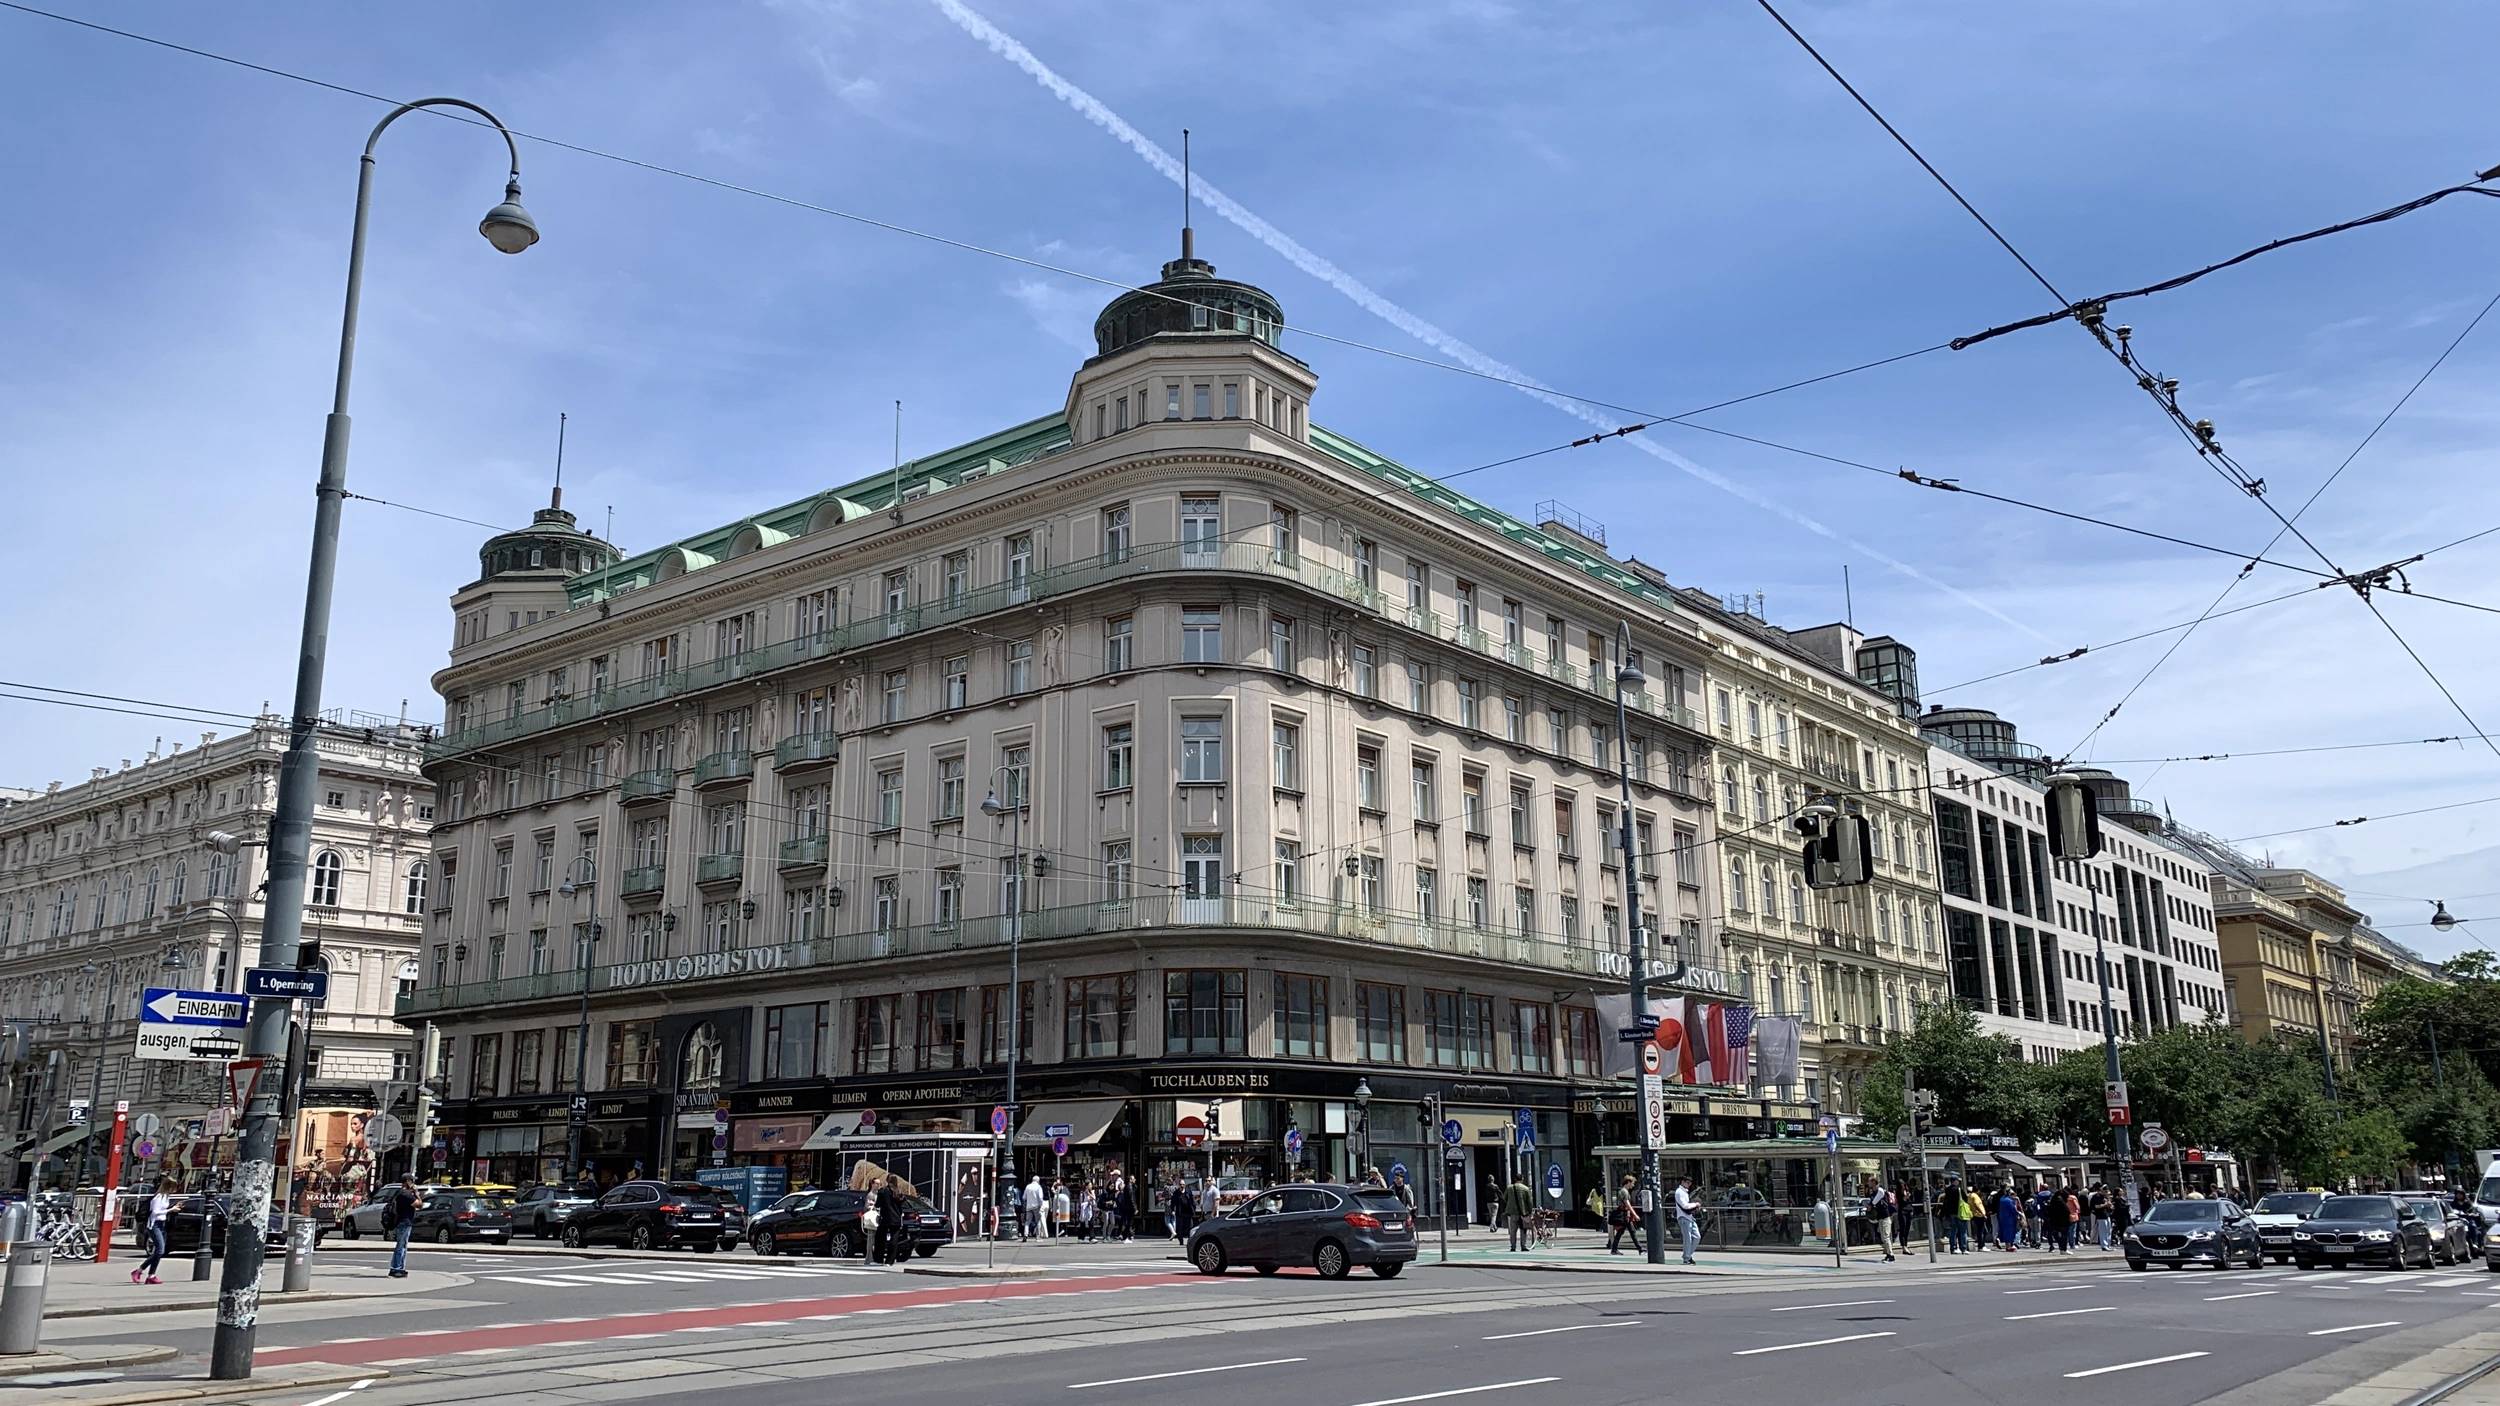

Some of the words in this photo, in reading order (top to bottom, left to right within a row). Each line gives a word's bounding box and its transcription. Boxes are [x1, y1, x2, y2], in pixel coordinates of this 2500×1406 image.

[609, 959, 676, 987] HOTEL
[693, 945, 788, 978] BRISTOL
[1596, 951, 1649, 979] HOTL
[270, 977, 315, 993] Opernring
[177, 1000, 237, 1018] EINBAHN
[140, 1032, 189, 1051] ausgen.
[1150, 1074, 1246, 1088] TUCHLAUBEN
[1249, 1074, 1269, 1087] EIS
[676, 1094, 687, 1107] SIR
[689, 1092, 719, 1106] ANTHONY
[832, 1092, 868, 1104] BLUMEN
[882, 1089, 912, 1101] OPERN
[914, 1087, 962, 1100] APOTHEKE
[571, 1097, 587, 1109] JR
[758, 1096, 793, 1107] MANNER
[1576, 1100, 1633, 1112] BRSTOL
[1668, 1101, 1691, 1113] OTEL
[492, 1109, 519, 1119] PALMERS
[548, 1107, 569, 1117] LINDT
[602, 1103, 623, 1115] LINDT
[1722, 1103, 1749, 1115] BRISTOL
[1781, 1107, 1801, 1118] HOTEL
[306, 1193, 354, 1201] MARCIANO
